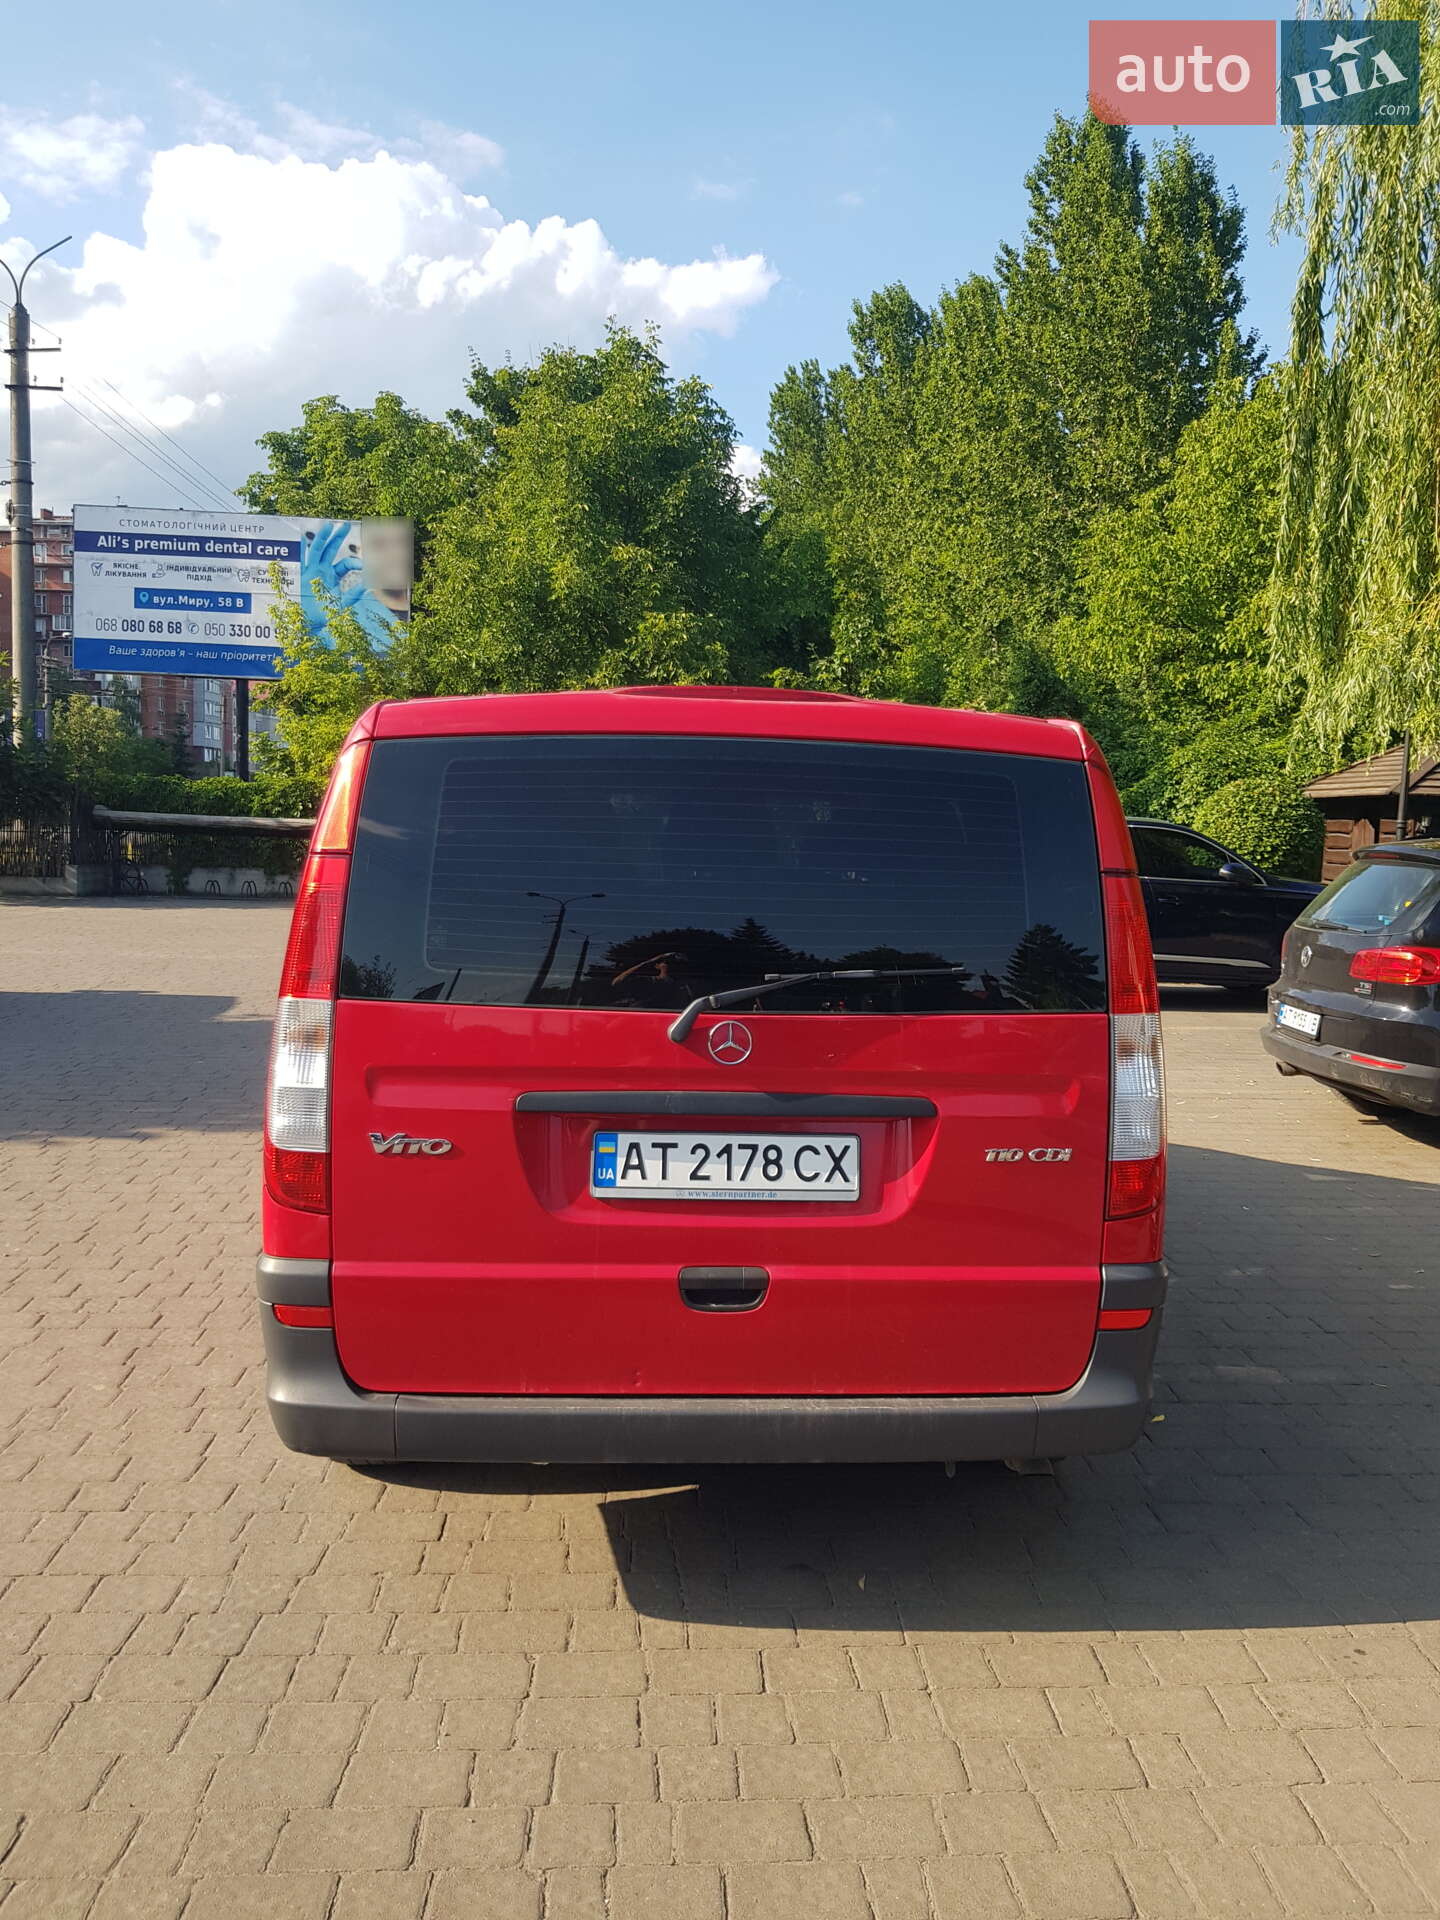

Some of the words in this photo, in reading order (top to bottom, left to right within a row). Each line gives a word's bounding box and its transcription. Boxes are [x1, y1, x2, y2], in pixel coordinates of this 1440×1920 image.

[119, 518, 227, 531] СТОМАТОЛОГІЧНИЙ
[229, 524, 265, 534] ЦЕНТР
[134, 537, 200, 552] premium
[205, 540, 252, 555] dental
[256, 544, 289, 556] care
[112, 562, 139, 570] ЯКІСНЕ
[166, 564, 233, 574] ІНДИВІДУАЛЬНИЙ
[104, 570, 147, 578] ЛІКУВАННЯ
[186, 574, 213, 582] ПІДХІД
[153, 595, 214, 608] вул.Миру,
[218, 596, 232, 607] 58
[95, 617, 117, 632] 068
[121, 619, 145, 633] 080
[148, 620, 164, 633] 68
[167, 620, 183, 634] 68
[204, 622, 226, 637] 050
[229, 624, 251, 638] 330
[255, 625, 270, 639] 00
[108, 645, 138, 656] Ваше
[196, 651, 218, 660] наш
[220, 649, 276, 663] пріоритет!
[984, 1147, 1024, 1162] 110
[620, 1141, 679, 1181] AT
[689, 1143, 784, 1182] 2178
[794, 1143, 852, 1183] CX
[598, 1167, 615, 1180] UA
[688, 1190, 778, 1199] www.sternpartner.de
